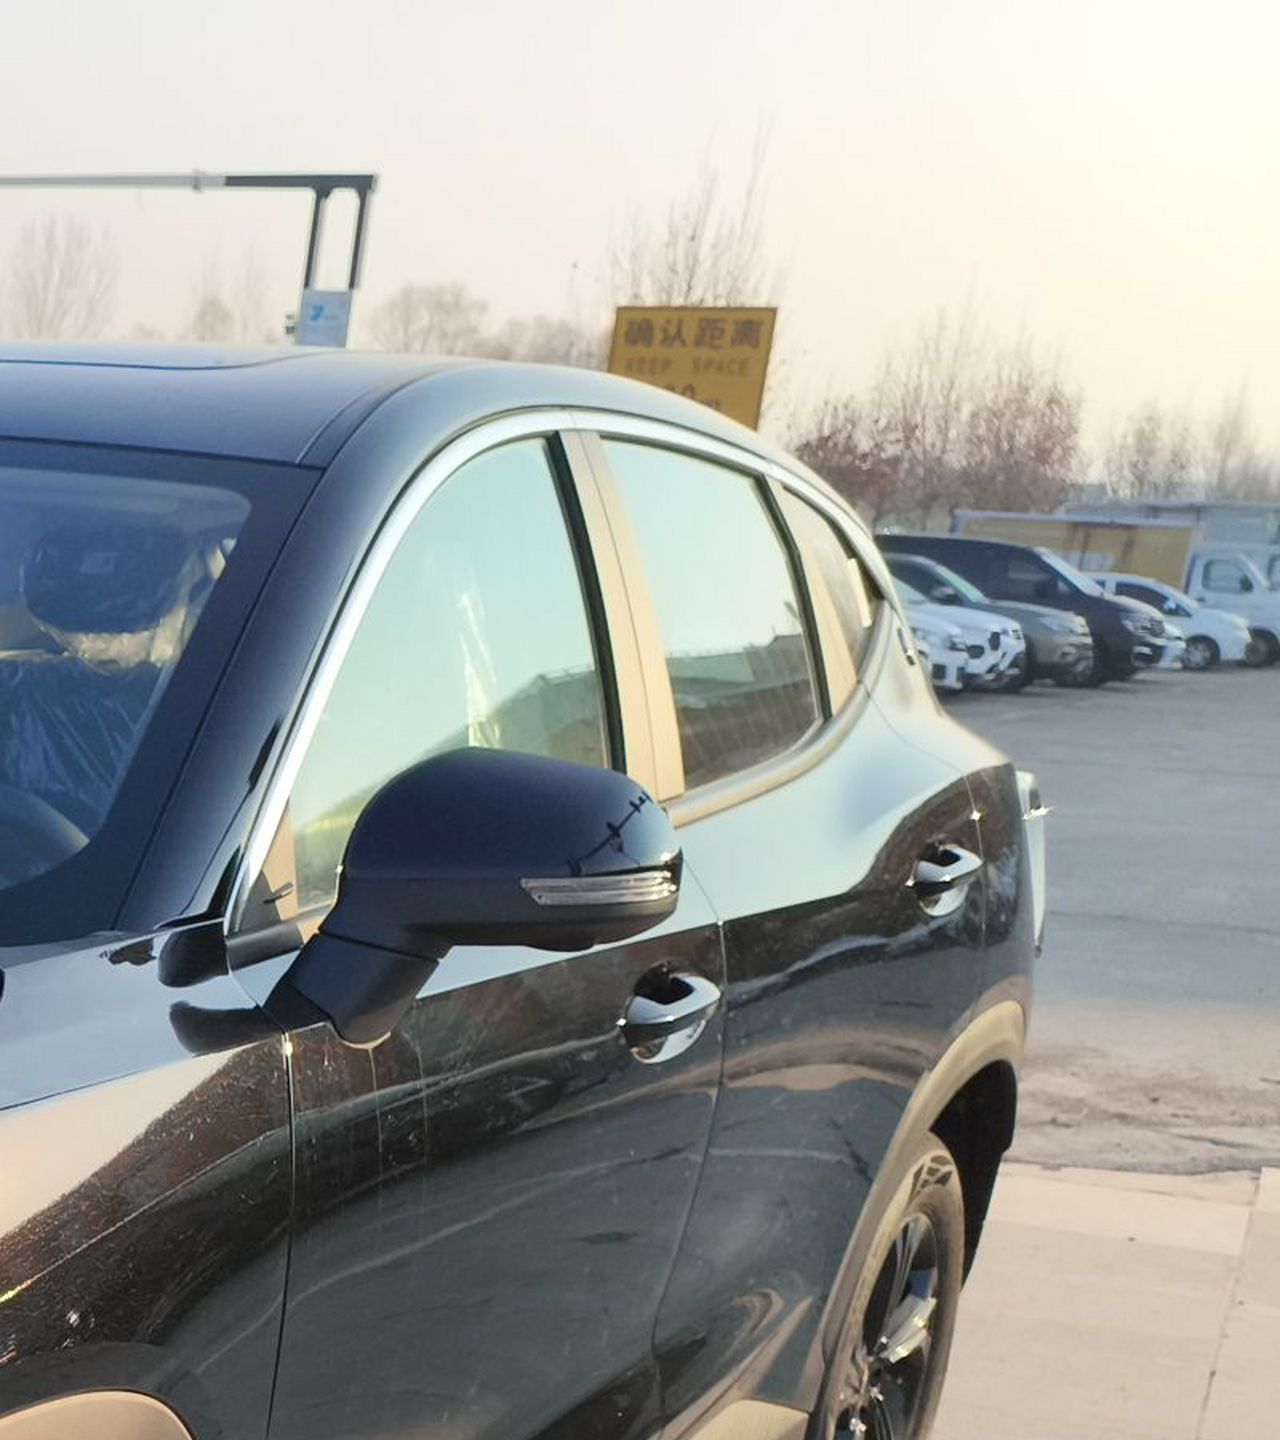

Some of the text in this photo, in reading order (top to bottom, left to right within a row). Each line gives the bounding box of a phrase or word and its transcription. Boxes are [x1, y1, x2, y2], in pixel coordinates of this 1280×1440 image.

[624, 318, 763, 350] 确认距离
[624, 356, 751, 377] KEEP SPACE
